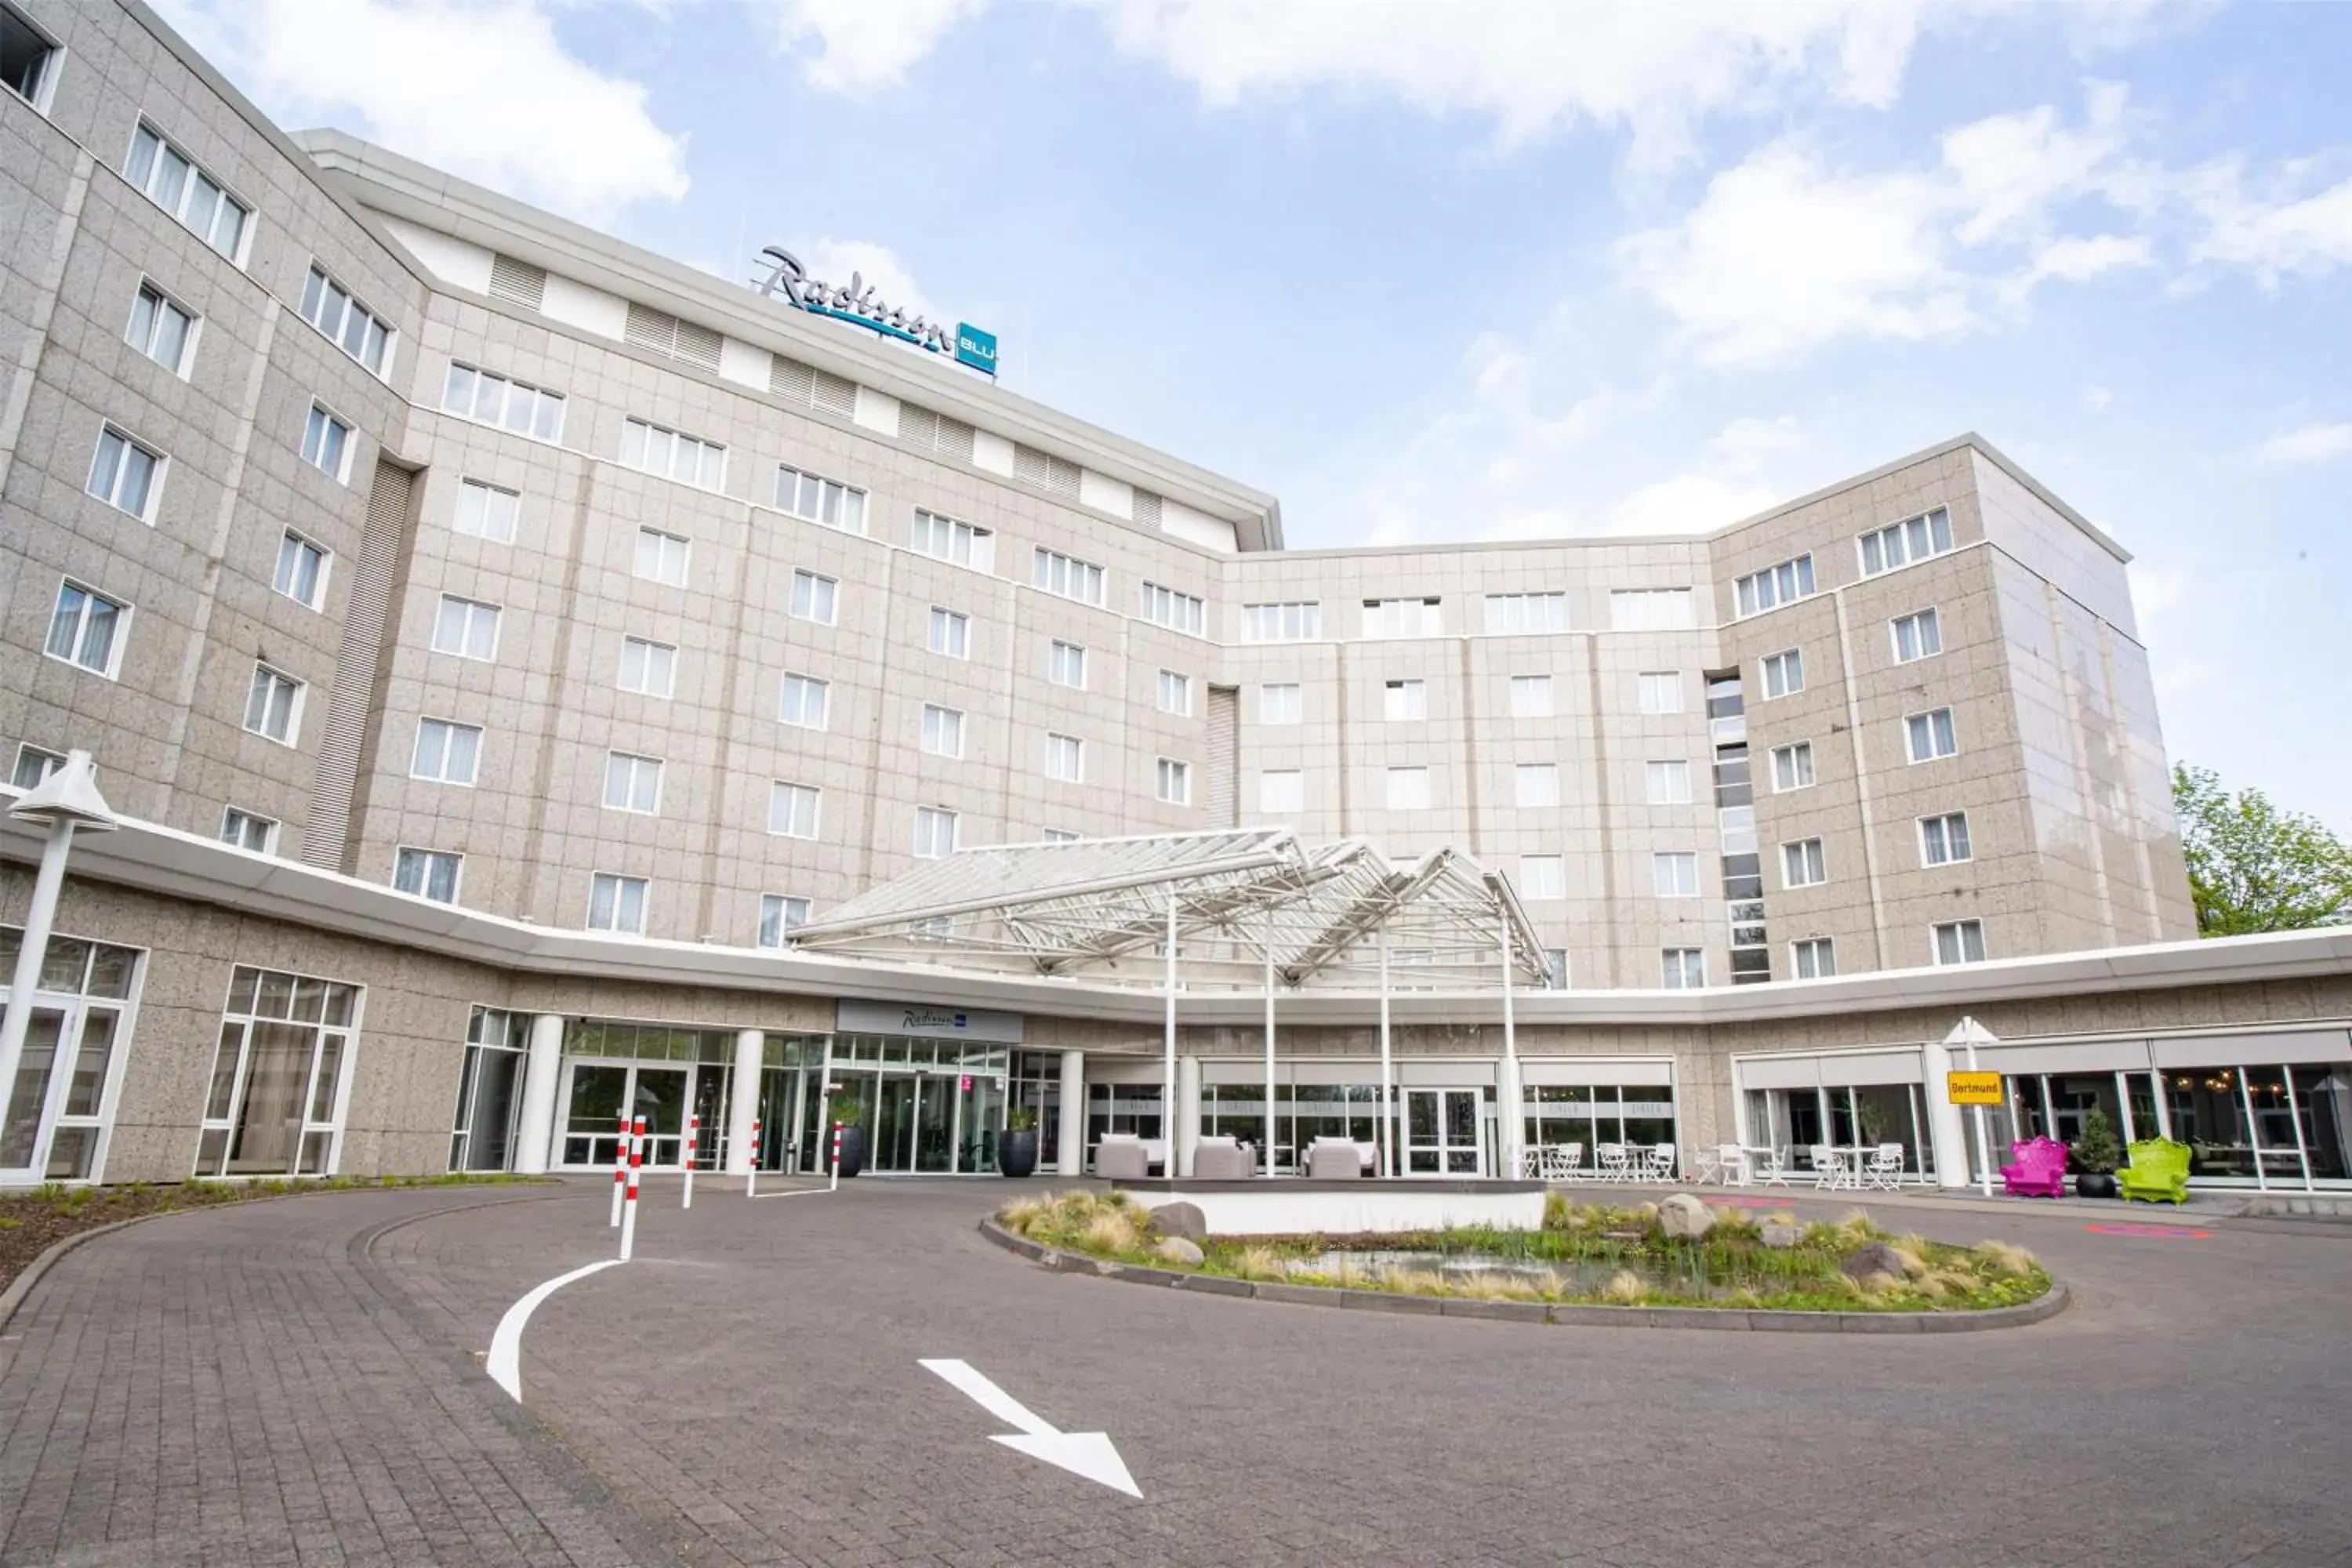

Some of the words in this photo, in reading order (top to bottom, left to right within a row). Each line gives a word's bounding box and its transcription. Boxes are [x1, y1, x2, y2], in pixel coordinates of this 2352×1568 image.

[760, 245, 952, 352] Radisson
[960, 336, 995, 359] BLU
[1951, 1082, 1998, 1094] Dortmund
